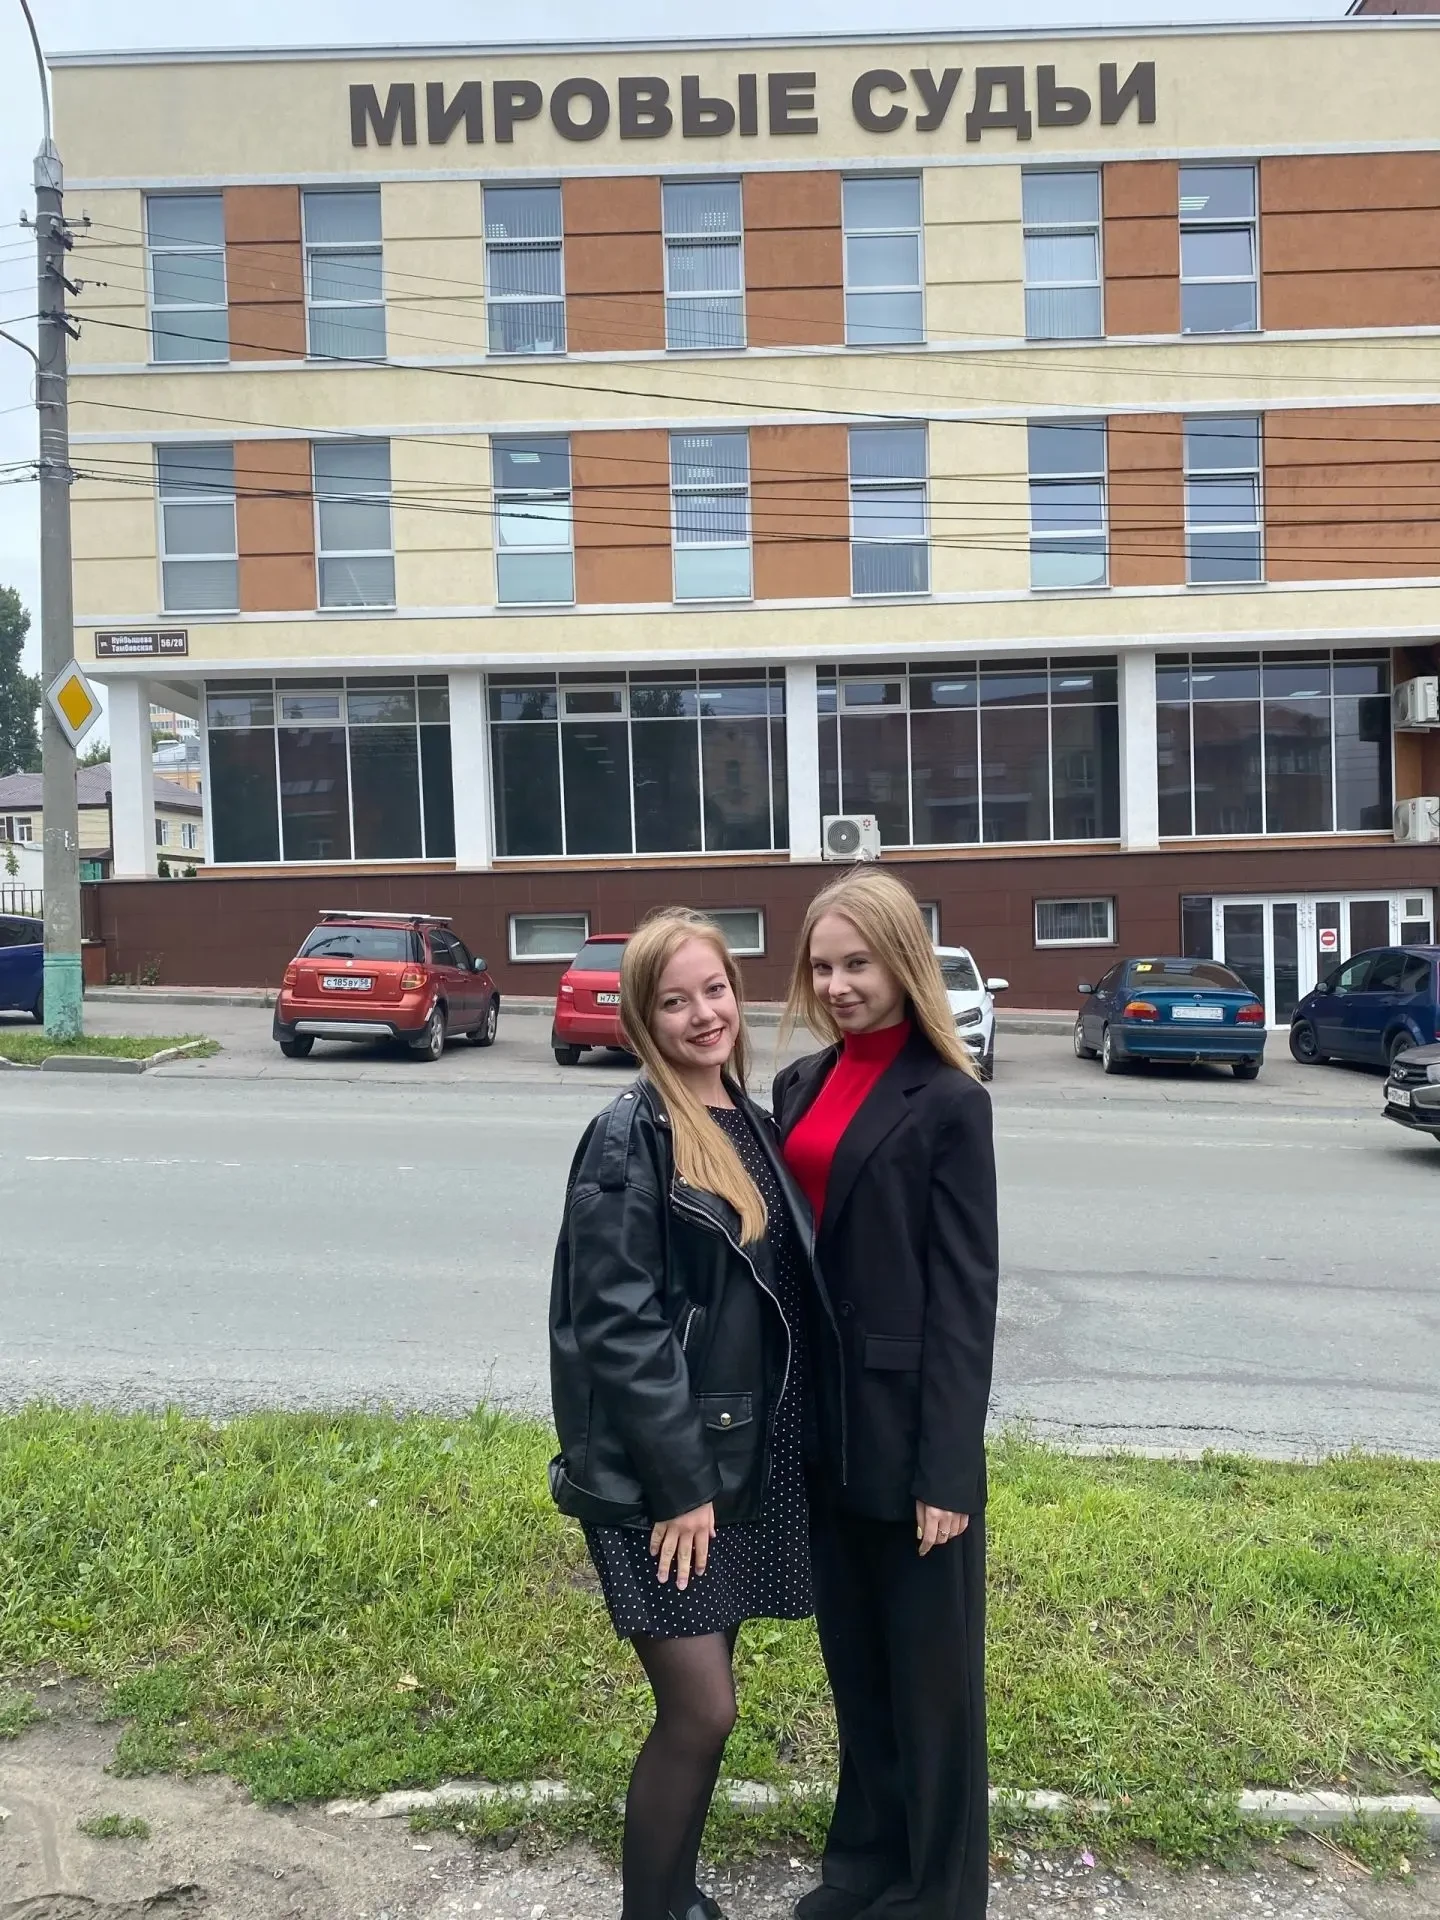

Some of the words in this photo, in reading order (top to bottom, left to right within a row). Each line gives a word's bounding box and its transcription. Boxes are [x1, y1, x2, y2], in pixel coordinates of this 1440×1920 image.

[350, 72, 819, 147] МИРОВЫЕ
[851, 61, 1157, 142] СУДЬИ
[161, 638, 183, 647] 56/28
